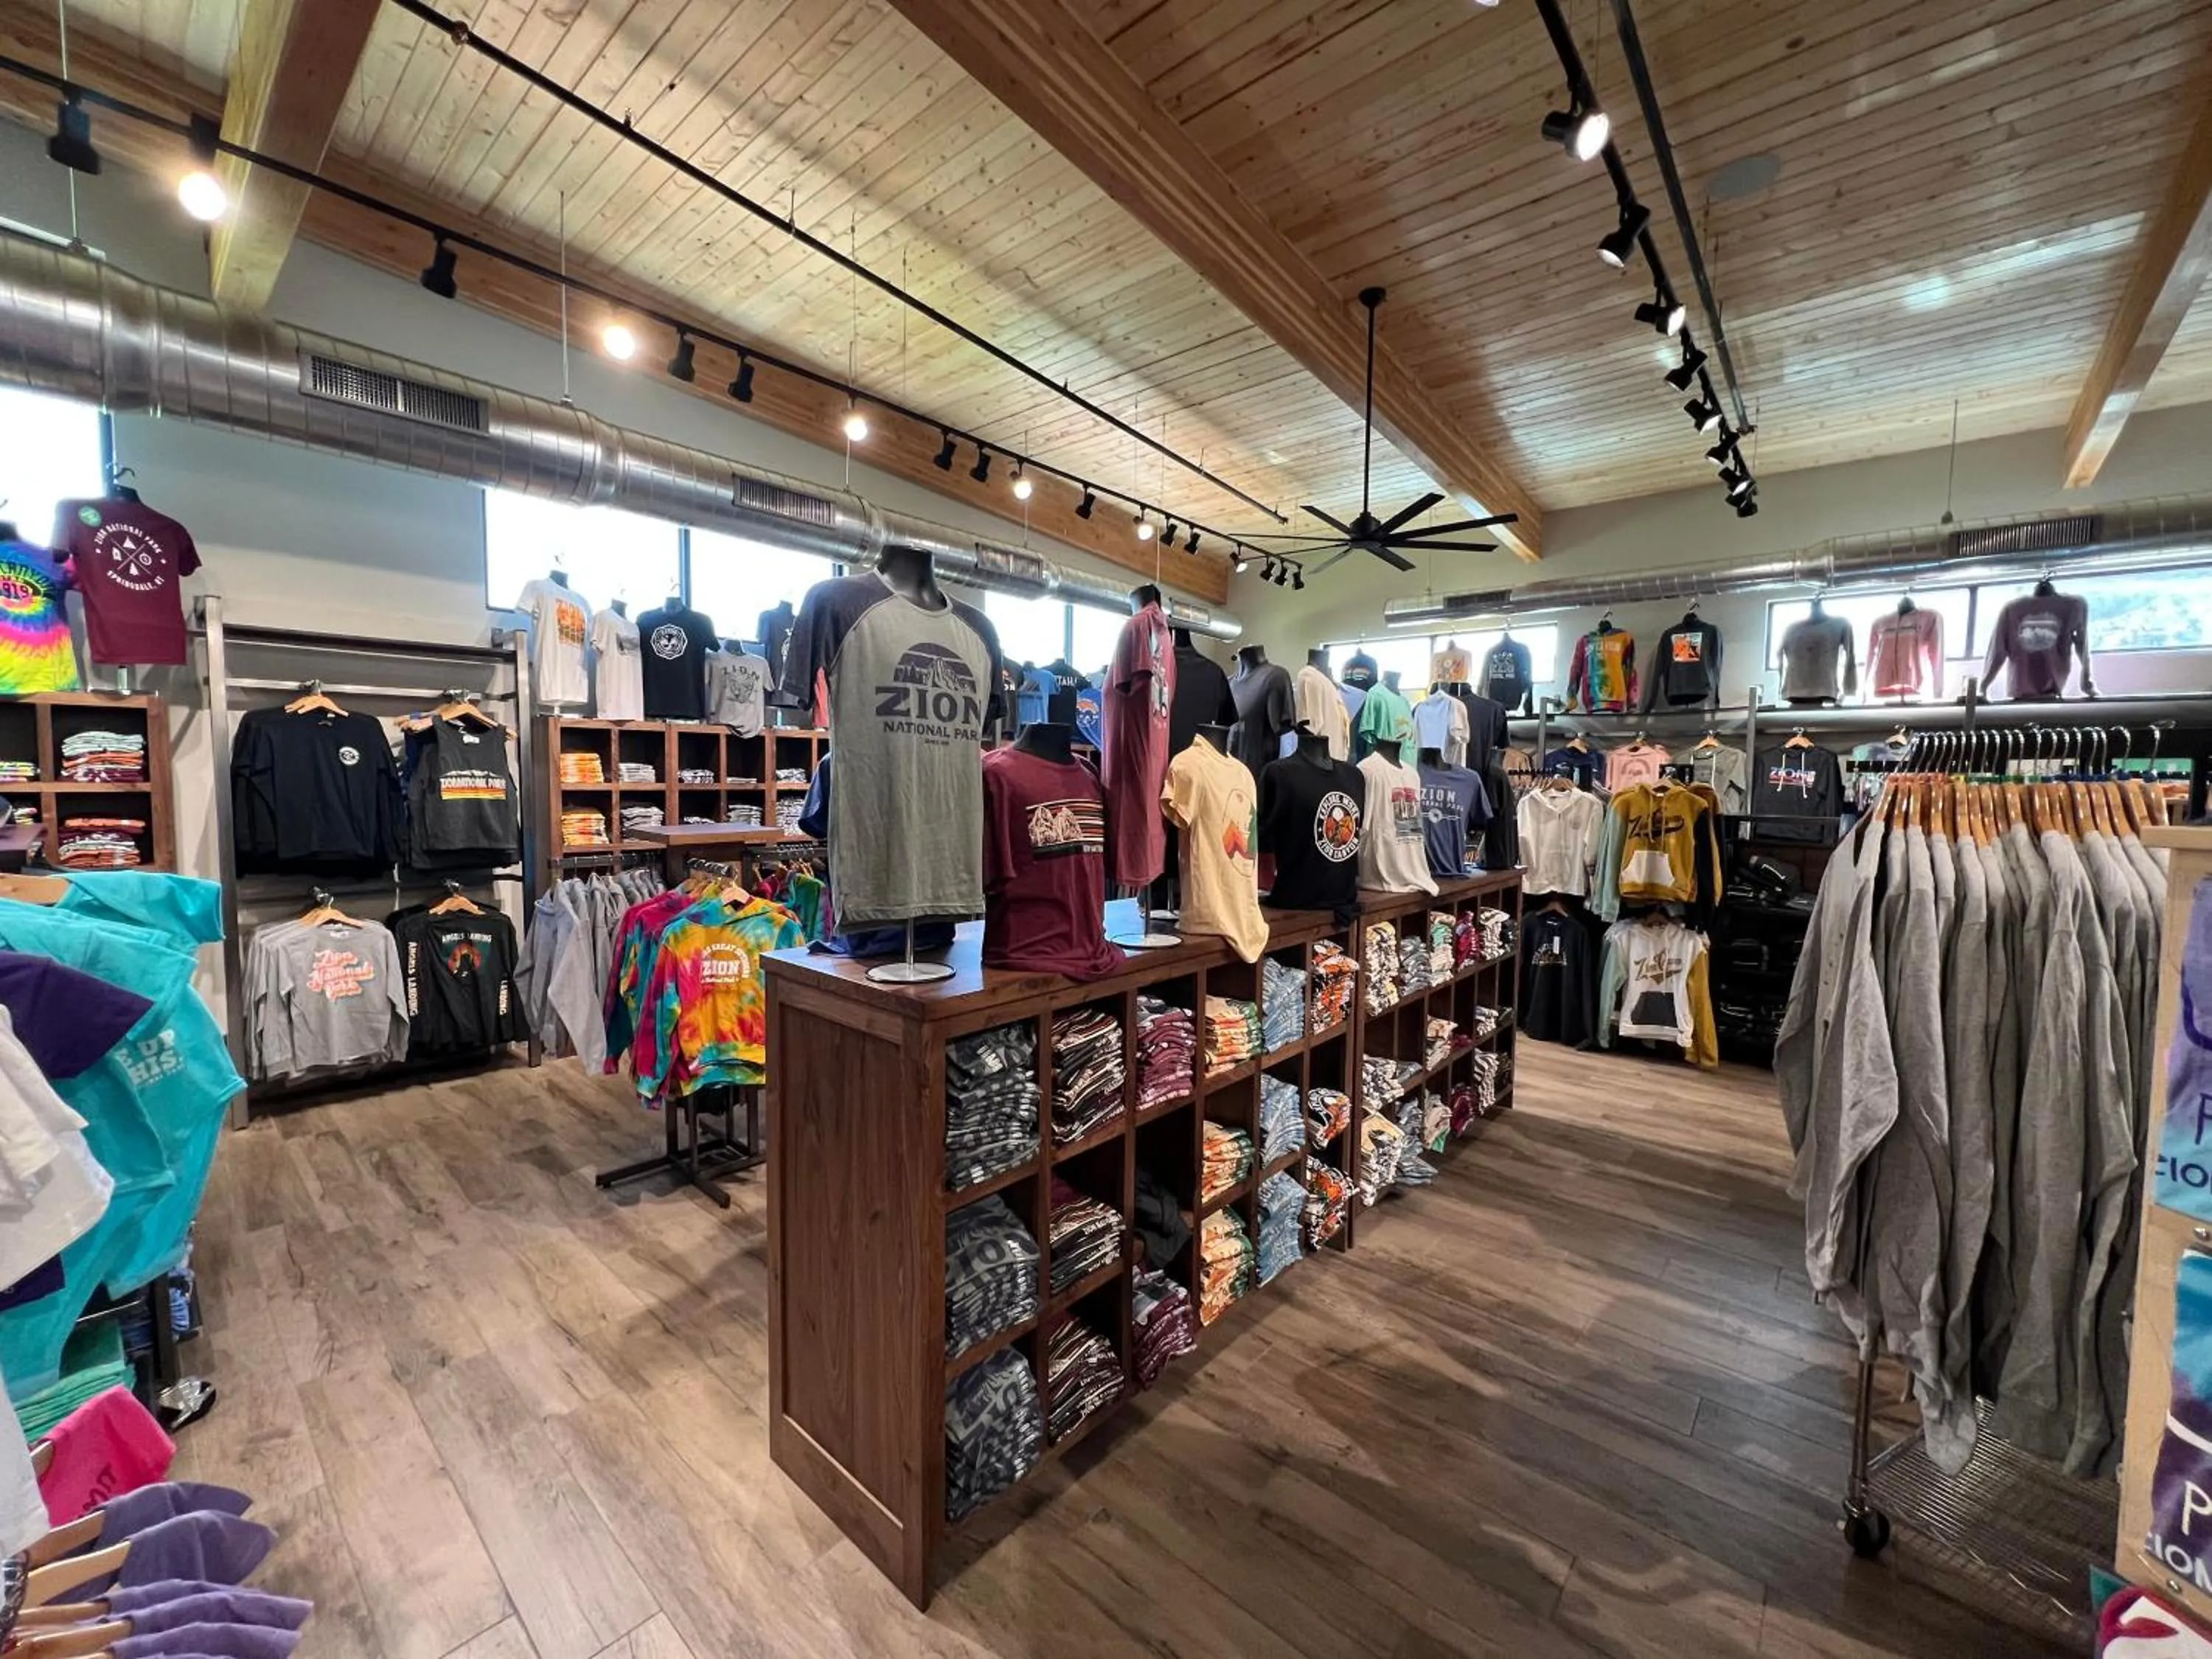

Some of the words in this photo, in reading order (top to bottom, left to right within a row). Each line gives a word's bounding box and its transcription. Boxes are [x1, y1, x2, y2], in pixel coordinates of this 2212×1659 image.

[875, 686, 981, 726] ZION
[883, 720, 951, 738] NATIONAL
[953, 727, 981, 742] PAR
[1420, 787, 1457, 804] ZION
[702, 960, 740, 976] ZION
